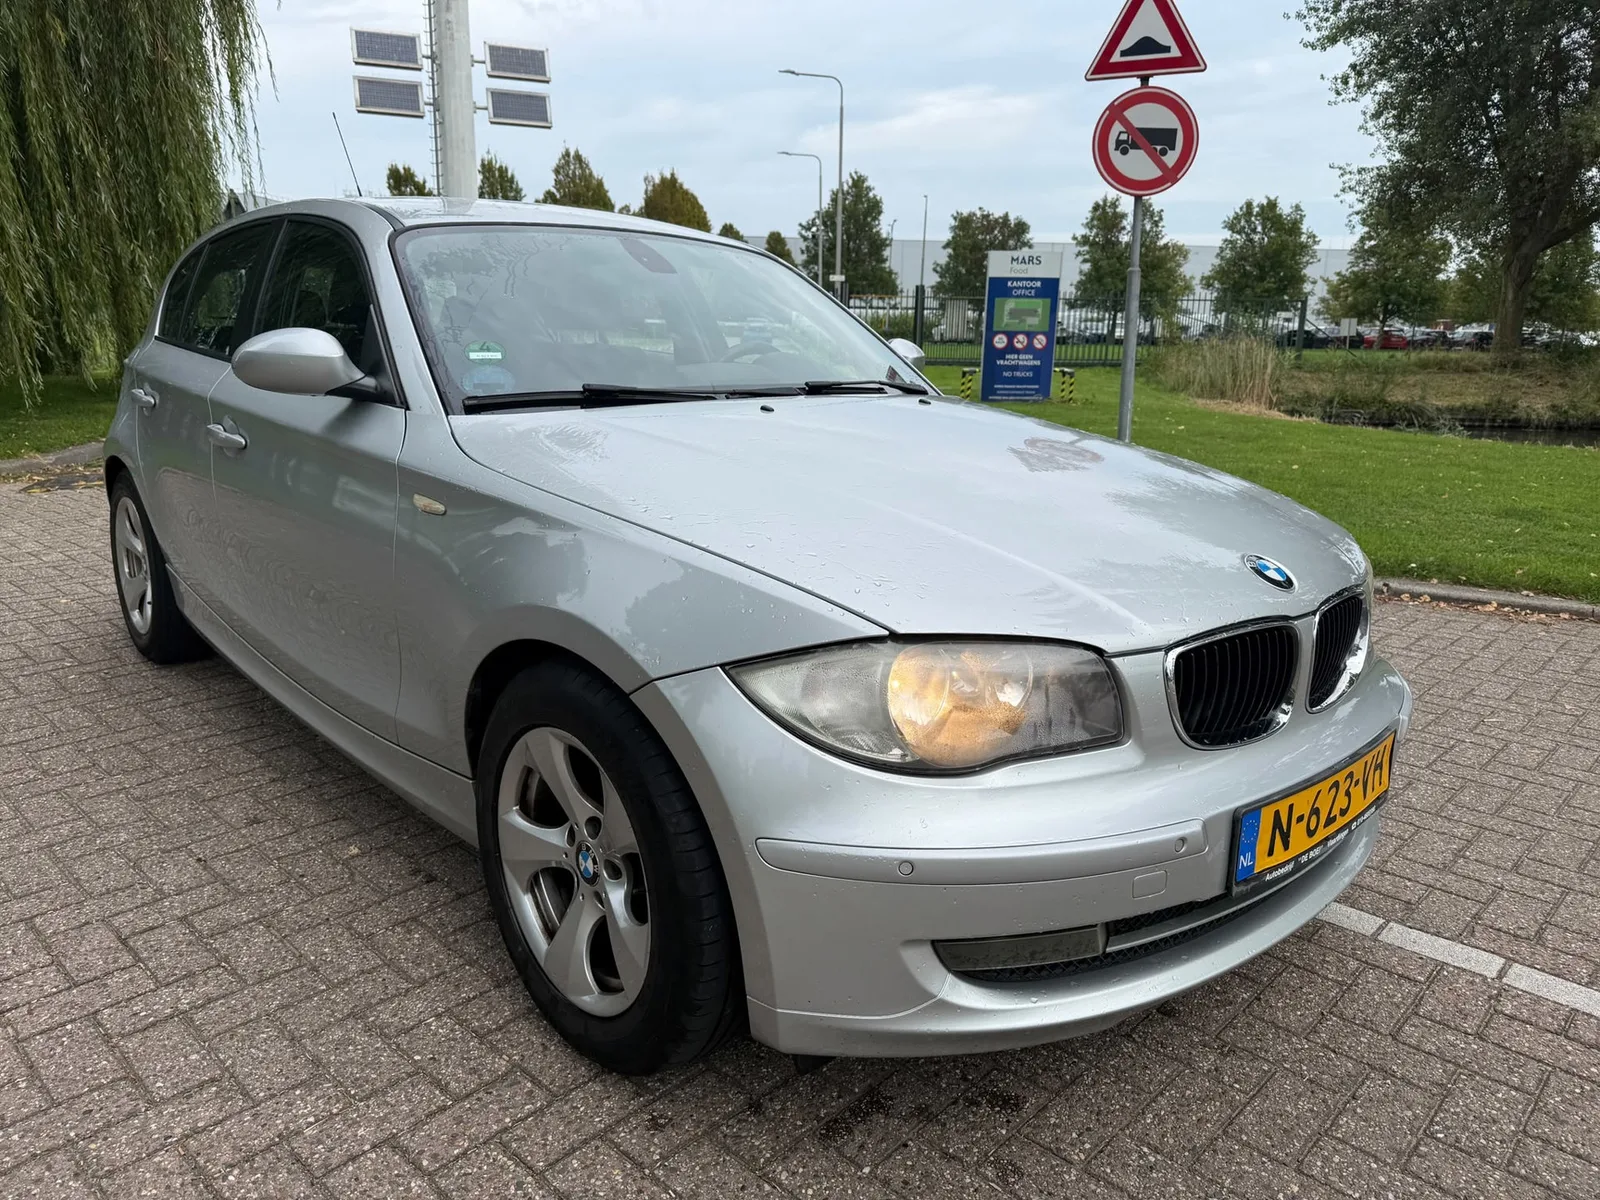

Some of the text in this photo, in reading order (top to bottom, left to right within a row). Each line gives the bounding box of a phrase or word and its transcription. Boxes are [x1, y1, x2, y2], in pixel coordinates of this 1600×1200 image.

[1010, 255, 1042, 266] MARS
[1010, 266, 1028, 275] Food
[1007, 280, 1041, 288] KANTOOR
[1267, 744, 1387, 857] N-623-VH
[1238, 851, 1253, 870] NL
